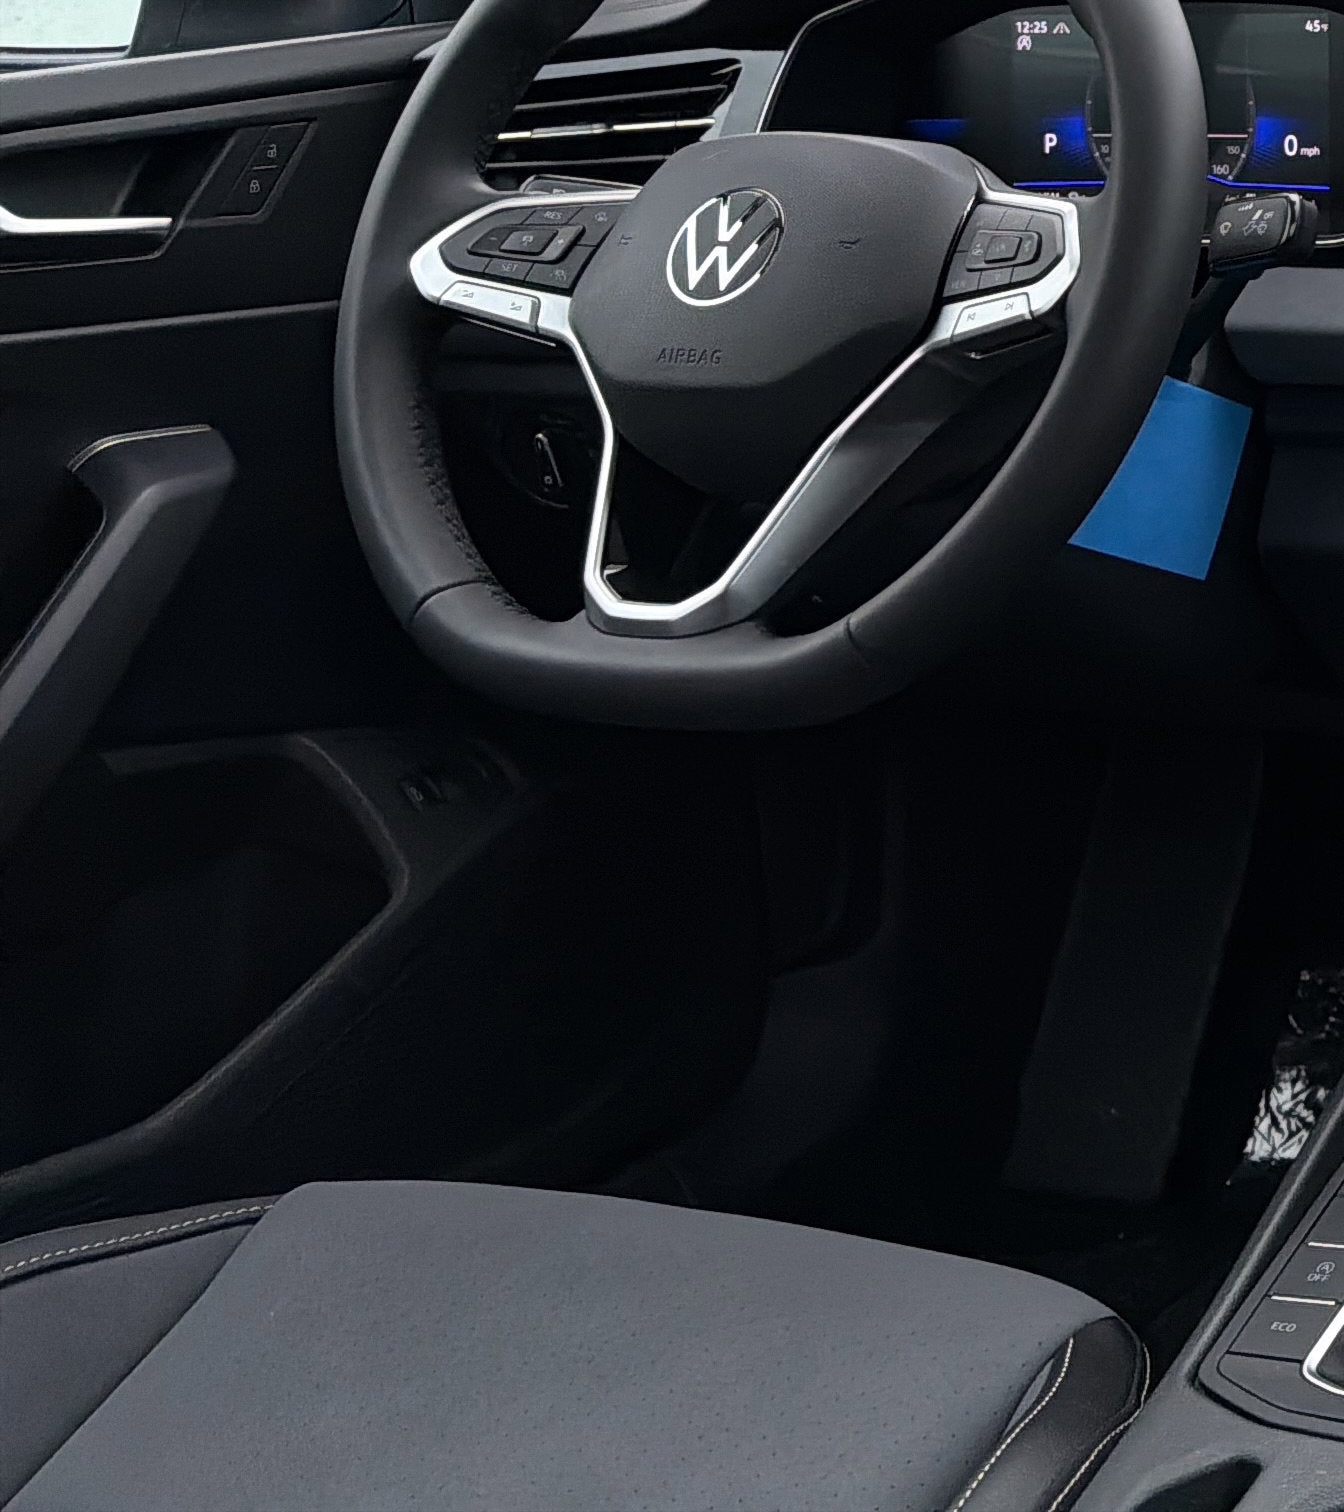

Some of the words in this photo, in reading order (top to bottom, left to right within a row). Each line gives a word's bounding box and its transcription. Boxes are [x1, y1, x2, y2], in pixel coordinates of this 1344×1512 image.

[1015, 21, 1048, 34] 12:25
[1043, 132, 1058, 155] P
[1283, 134, 1299, 157] 0
[1300, 146, 1321, 158] mph
[1225, 145, 1241, 155] 150
[1211, 163, 1230, 176] 160
[543, 210, 563, 220] RES
[501, 263, 519, 273] SET
[656, 347, 722, 365] AIRBAG
[1306, 1273, 1331, 1282] OFF
[1270, 1321, 1297, 1332] ECO
